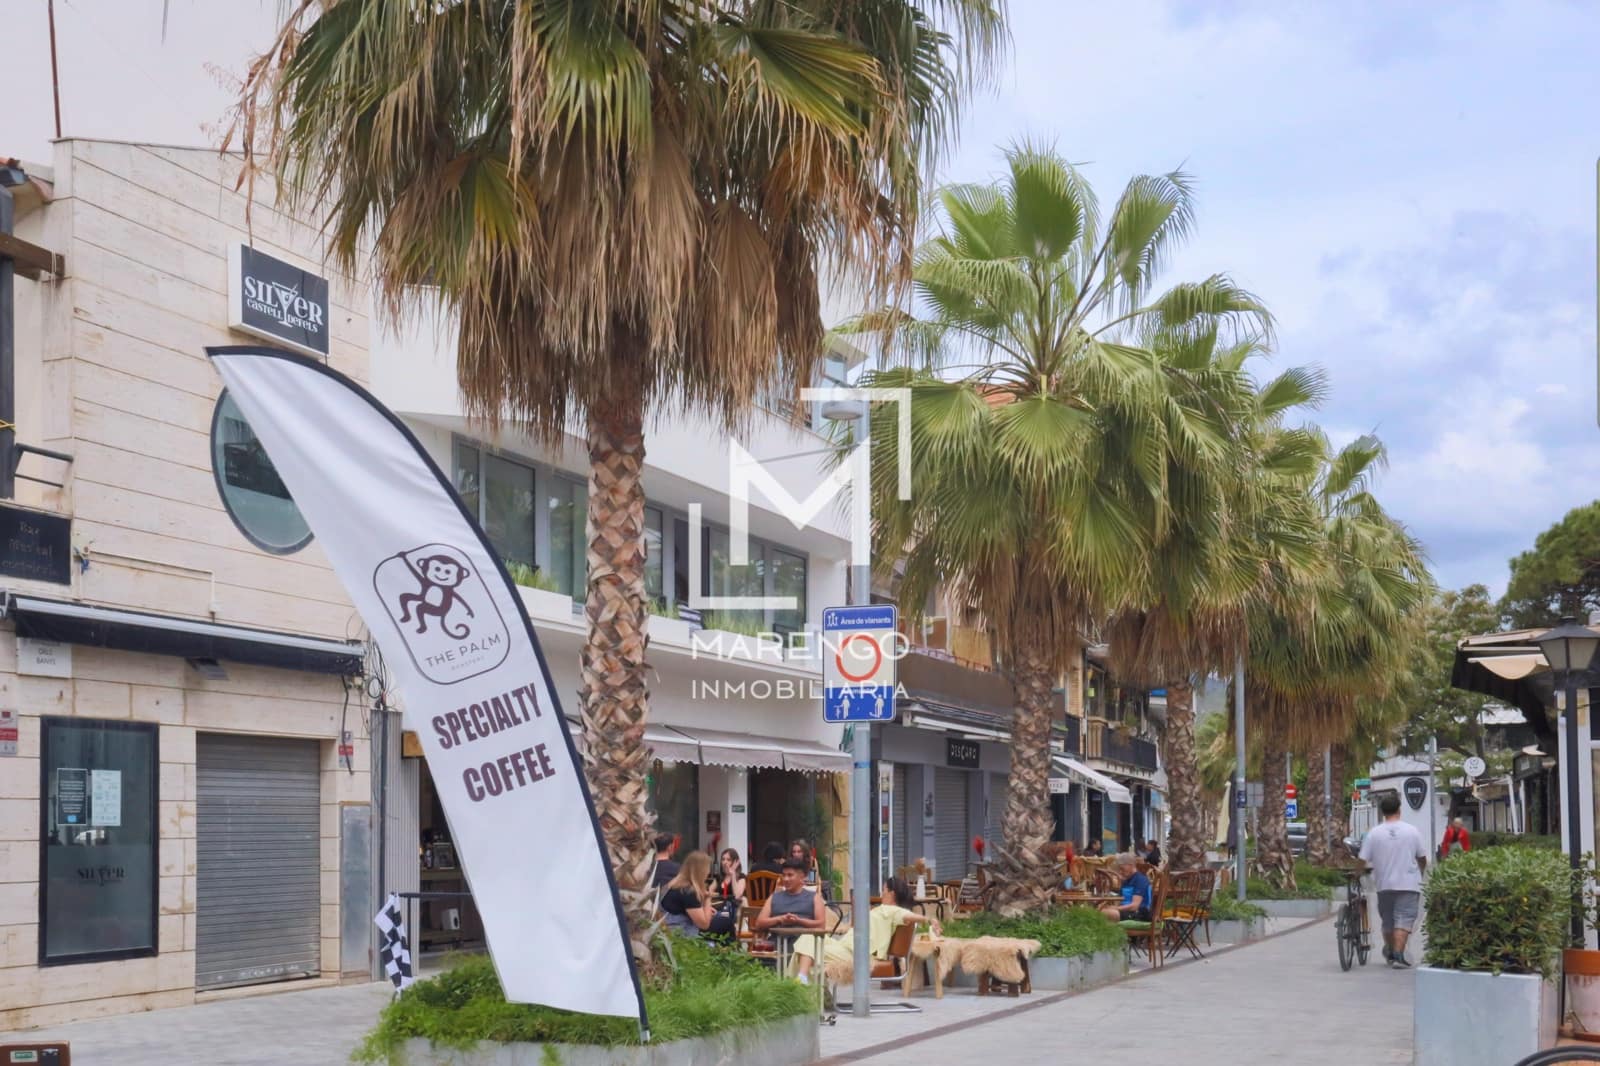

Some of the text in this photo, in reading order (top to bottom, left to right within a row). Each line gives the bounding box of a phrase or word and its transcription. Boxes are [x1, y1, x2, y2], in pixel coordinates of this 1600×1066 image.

[425, 649, 456, 668] THE
[459, 634, 501, 656] PALM
[432, 683, 542, 750] SPECIALTY
[462, 743, 556, 802] COFFEE
